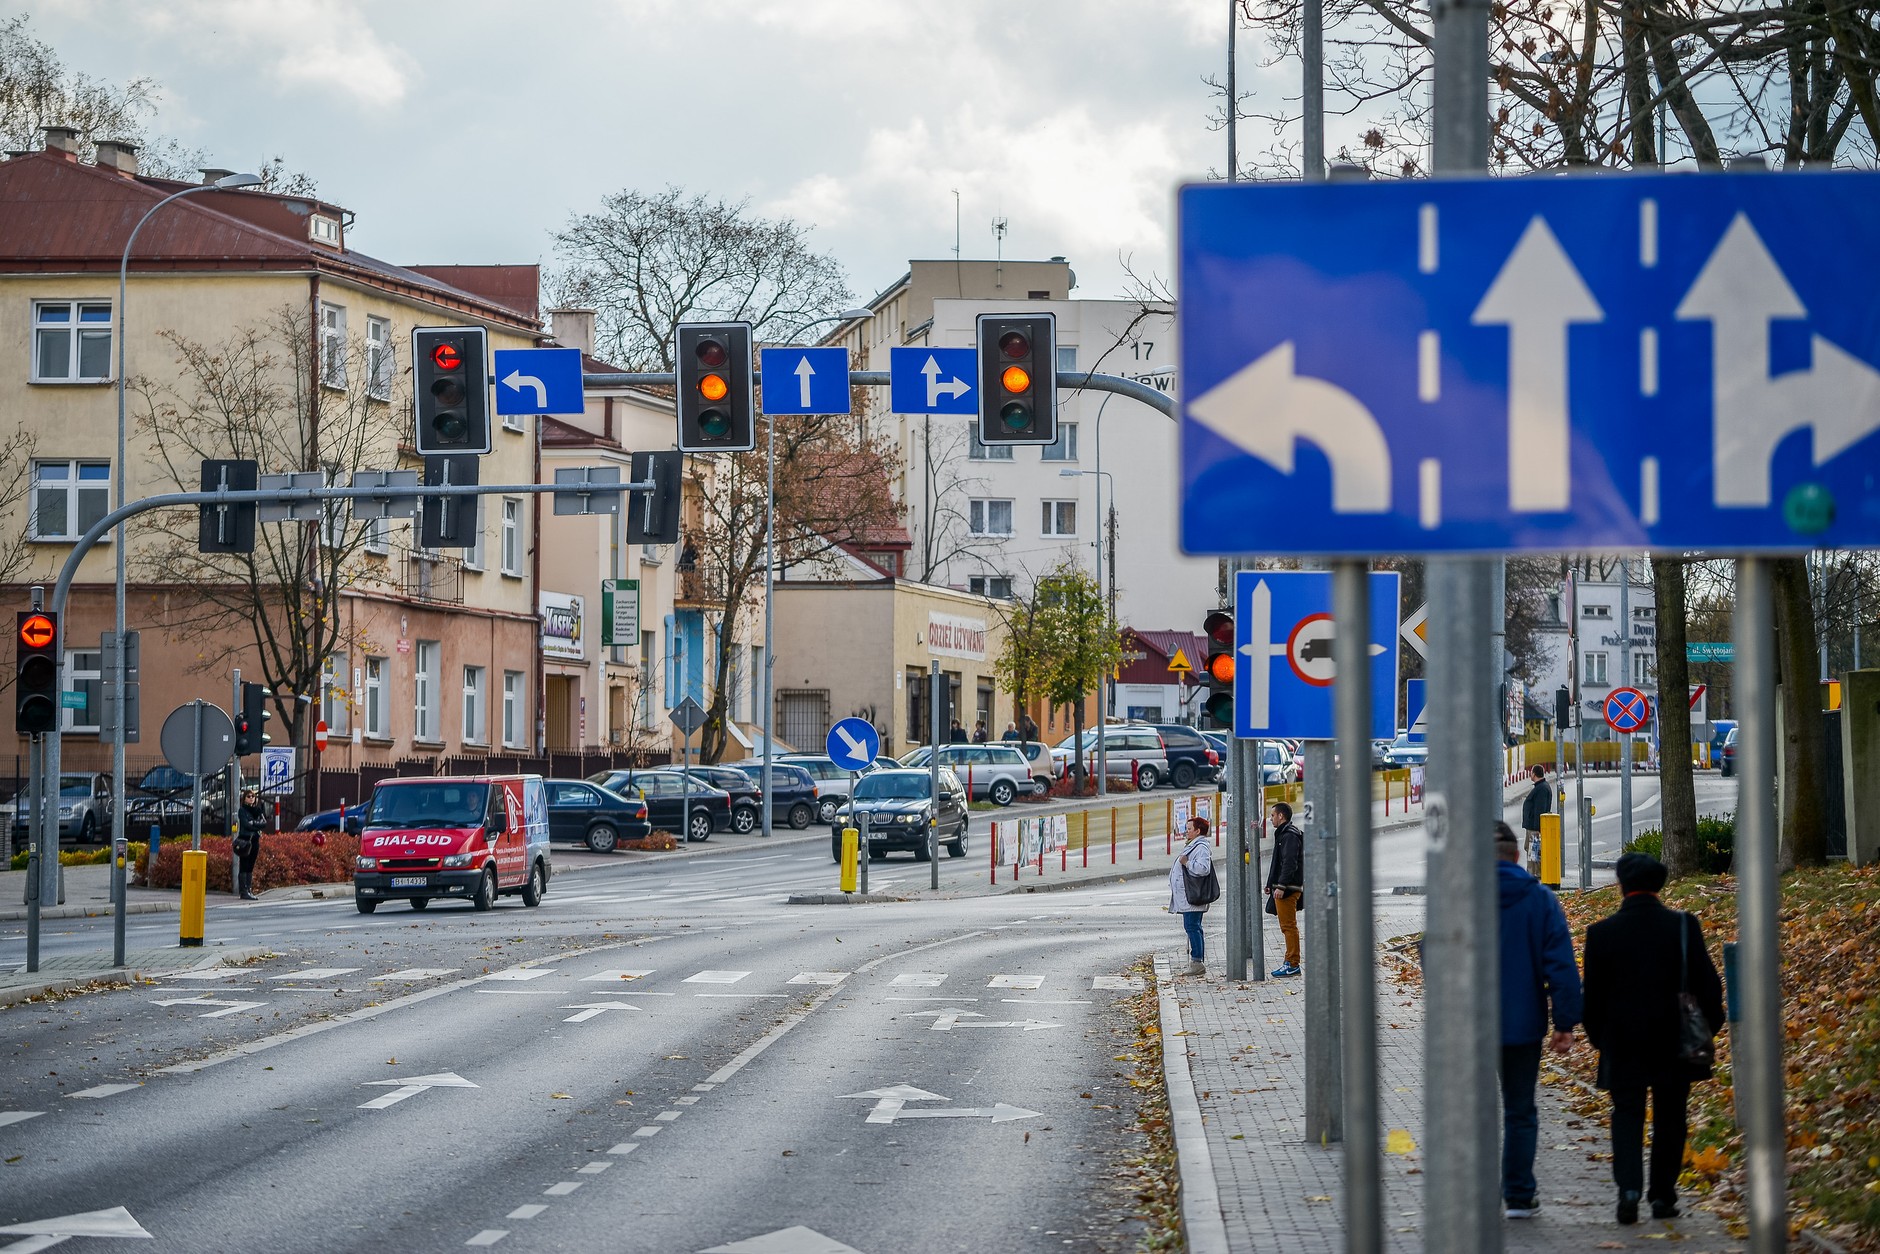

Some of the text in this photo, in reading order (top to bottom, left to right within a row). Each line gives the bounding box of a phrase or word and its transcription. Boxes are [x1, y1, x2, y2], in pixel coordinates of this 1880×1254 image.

[1130, 341, 1154, 360] 17
[1634, 624, 1655, 636] Dom
[929, 621, 985, 653] ODZIEŻ UŻYWANA
[1692, 646, 1701, 654] ul.
[373, 835, 452, 847] BIAL-BUD
